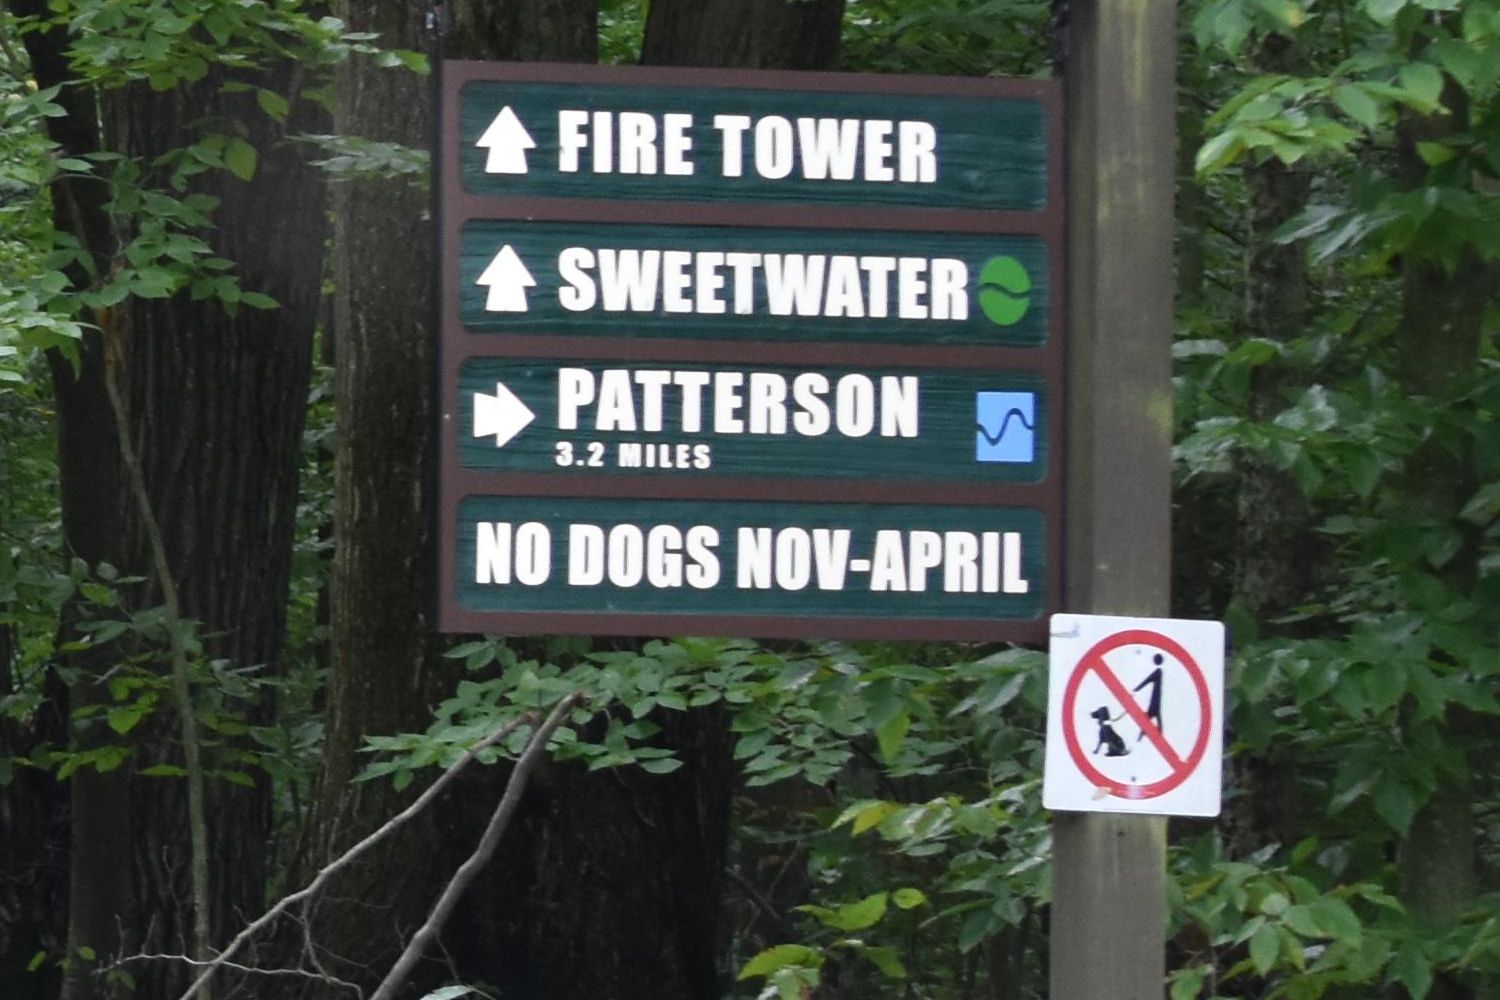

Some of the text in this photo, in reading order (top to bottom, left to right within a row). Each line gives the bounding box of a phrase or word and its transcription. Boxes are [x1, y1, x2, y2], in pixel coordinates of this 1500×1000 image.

[558, 109, 937, 183] FIRE TOWER
[557, 246, 969, 321] SWEETWATER
[558, 367, 919, 438] PATTERSON
[555, 441, 711, 470] 3.2 MILES
[475, 521, 1029, 594] NO DOGS NOV-APRIL
